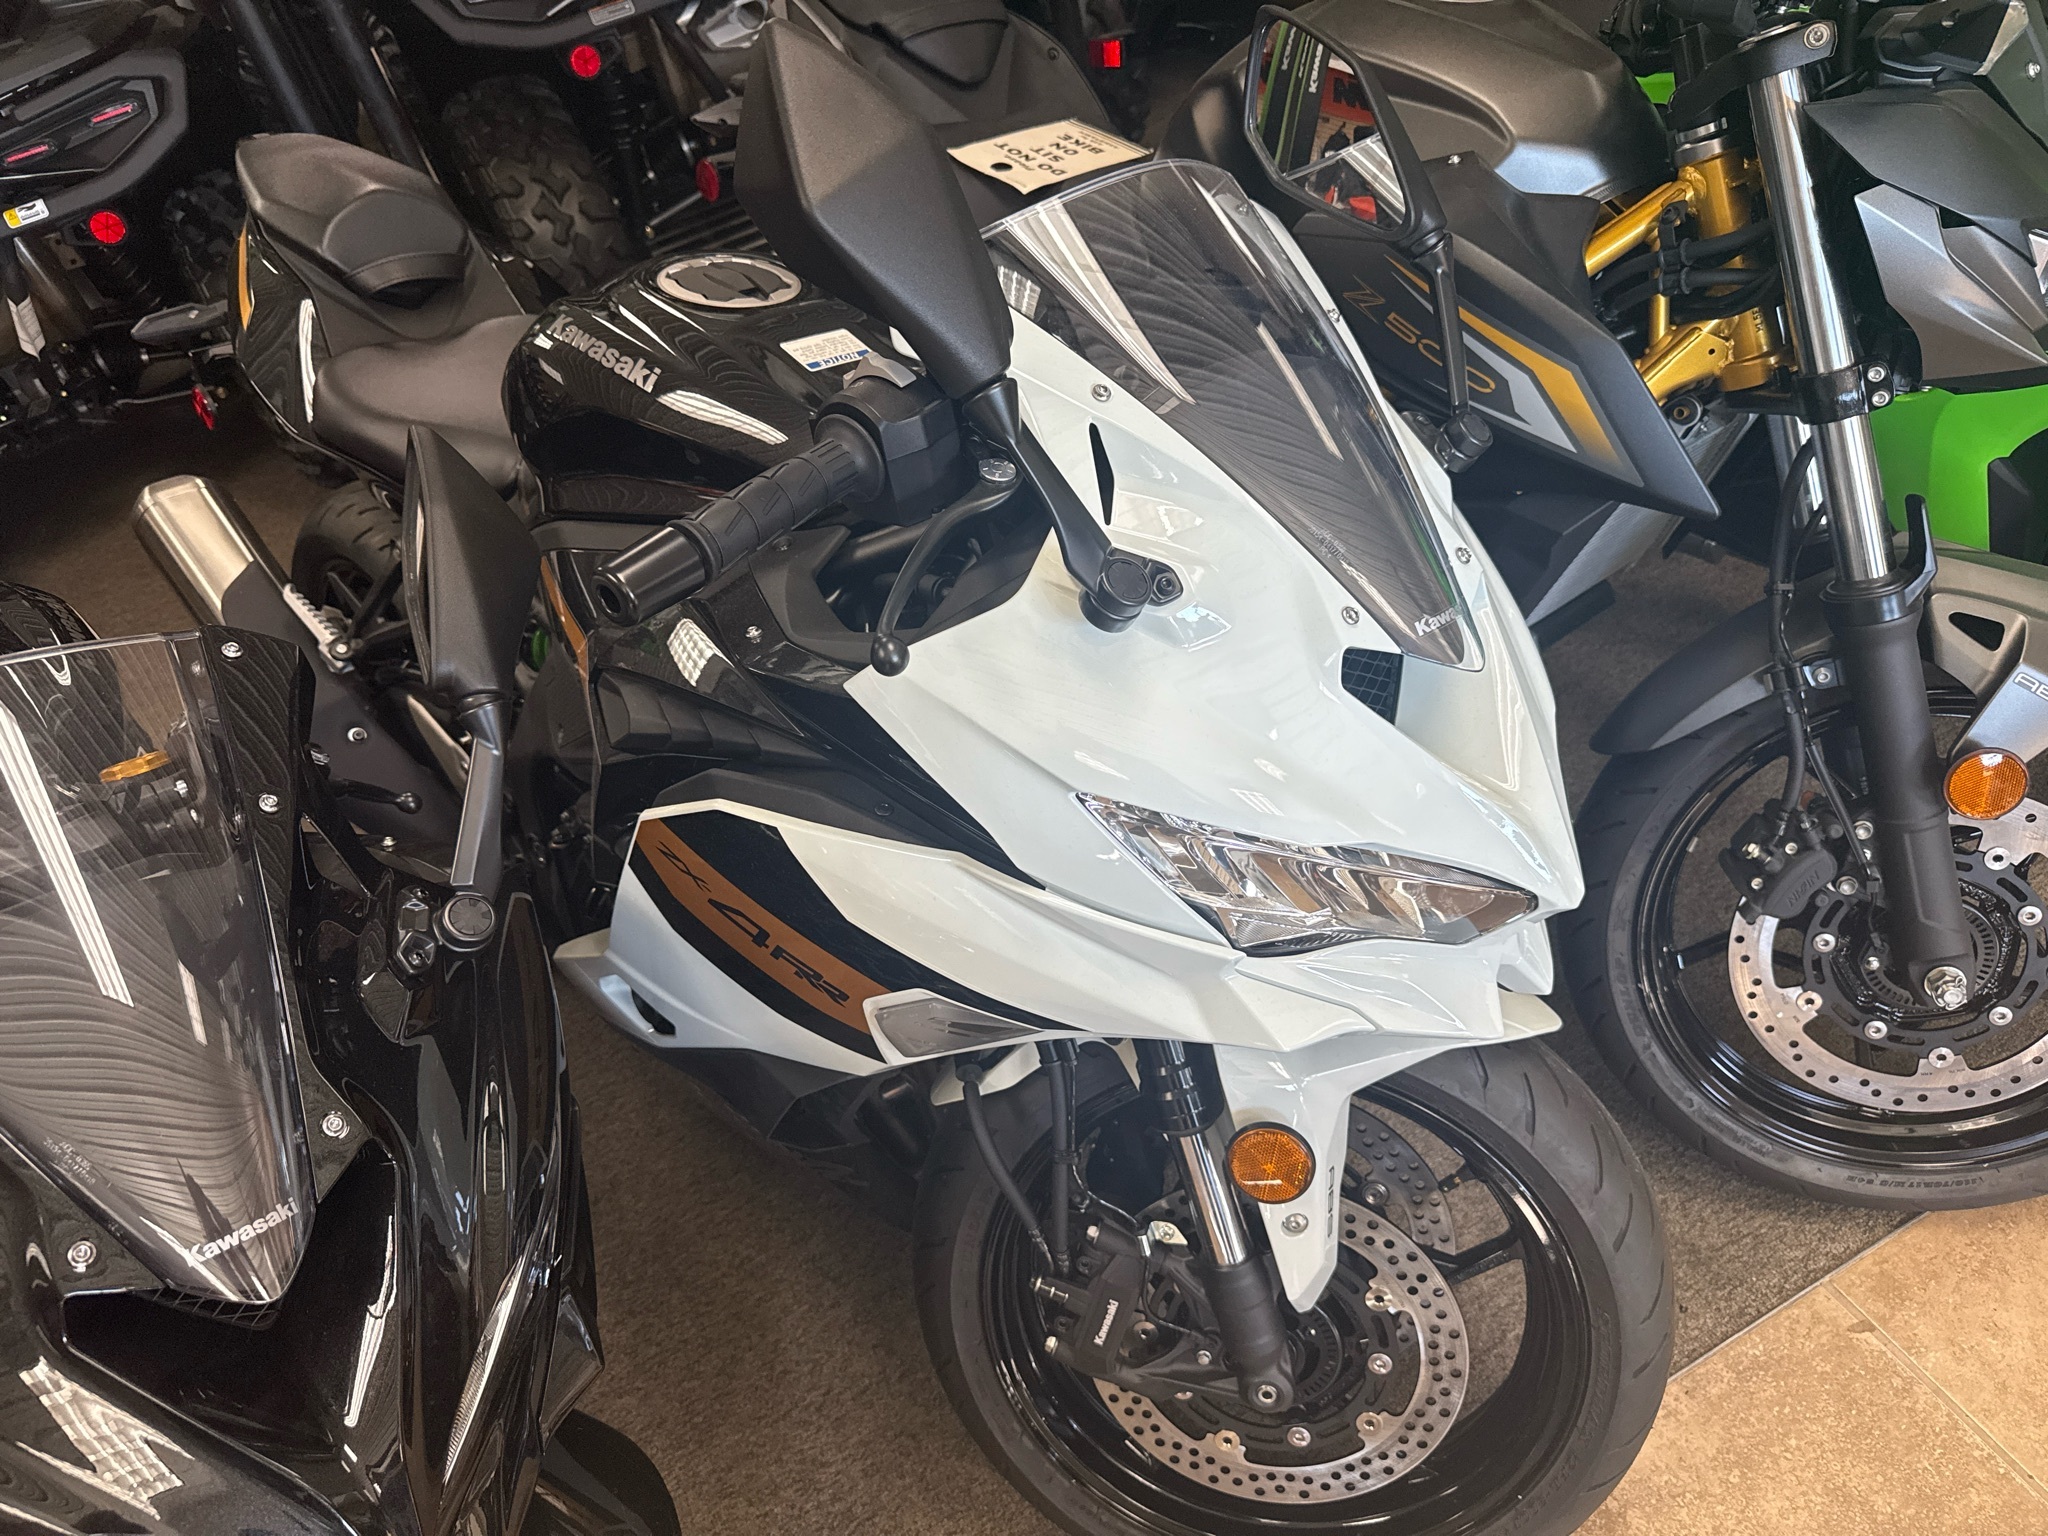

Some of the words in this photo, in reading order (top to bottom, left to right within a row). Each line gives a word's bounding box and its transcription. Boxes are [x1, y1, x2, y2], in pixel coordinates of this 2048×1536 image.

[994, 142, 1036, 163] NOT
[1050, 142, 1079, 156] ON
[1057, 133, 1106, 155] BIKE
[1030, 147, 1064, 163] SIT
[1038, 163, 1068, 176] DO
[546, 313, 661, 393] Kawasaki
[819, 351, 858, 366] NOTICE
[1327, 1166, 1336, 1238] ABS
[187, 1196, 299, 1263] Kawasaki
[1094, 1299, 1119, 1346] Kawasaki
